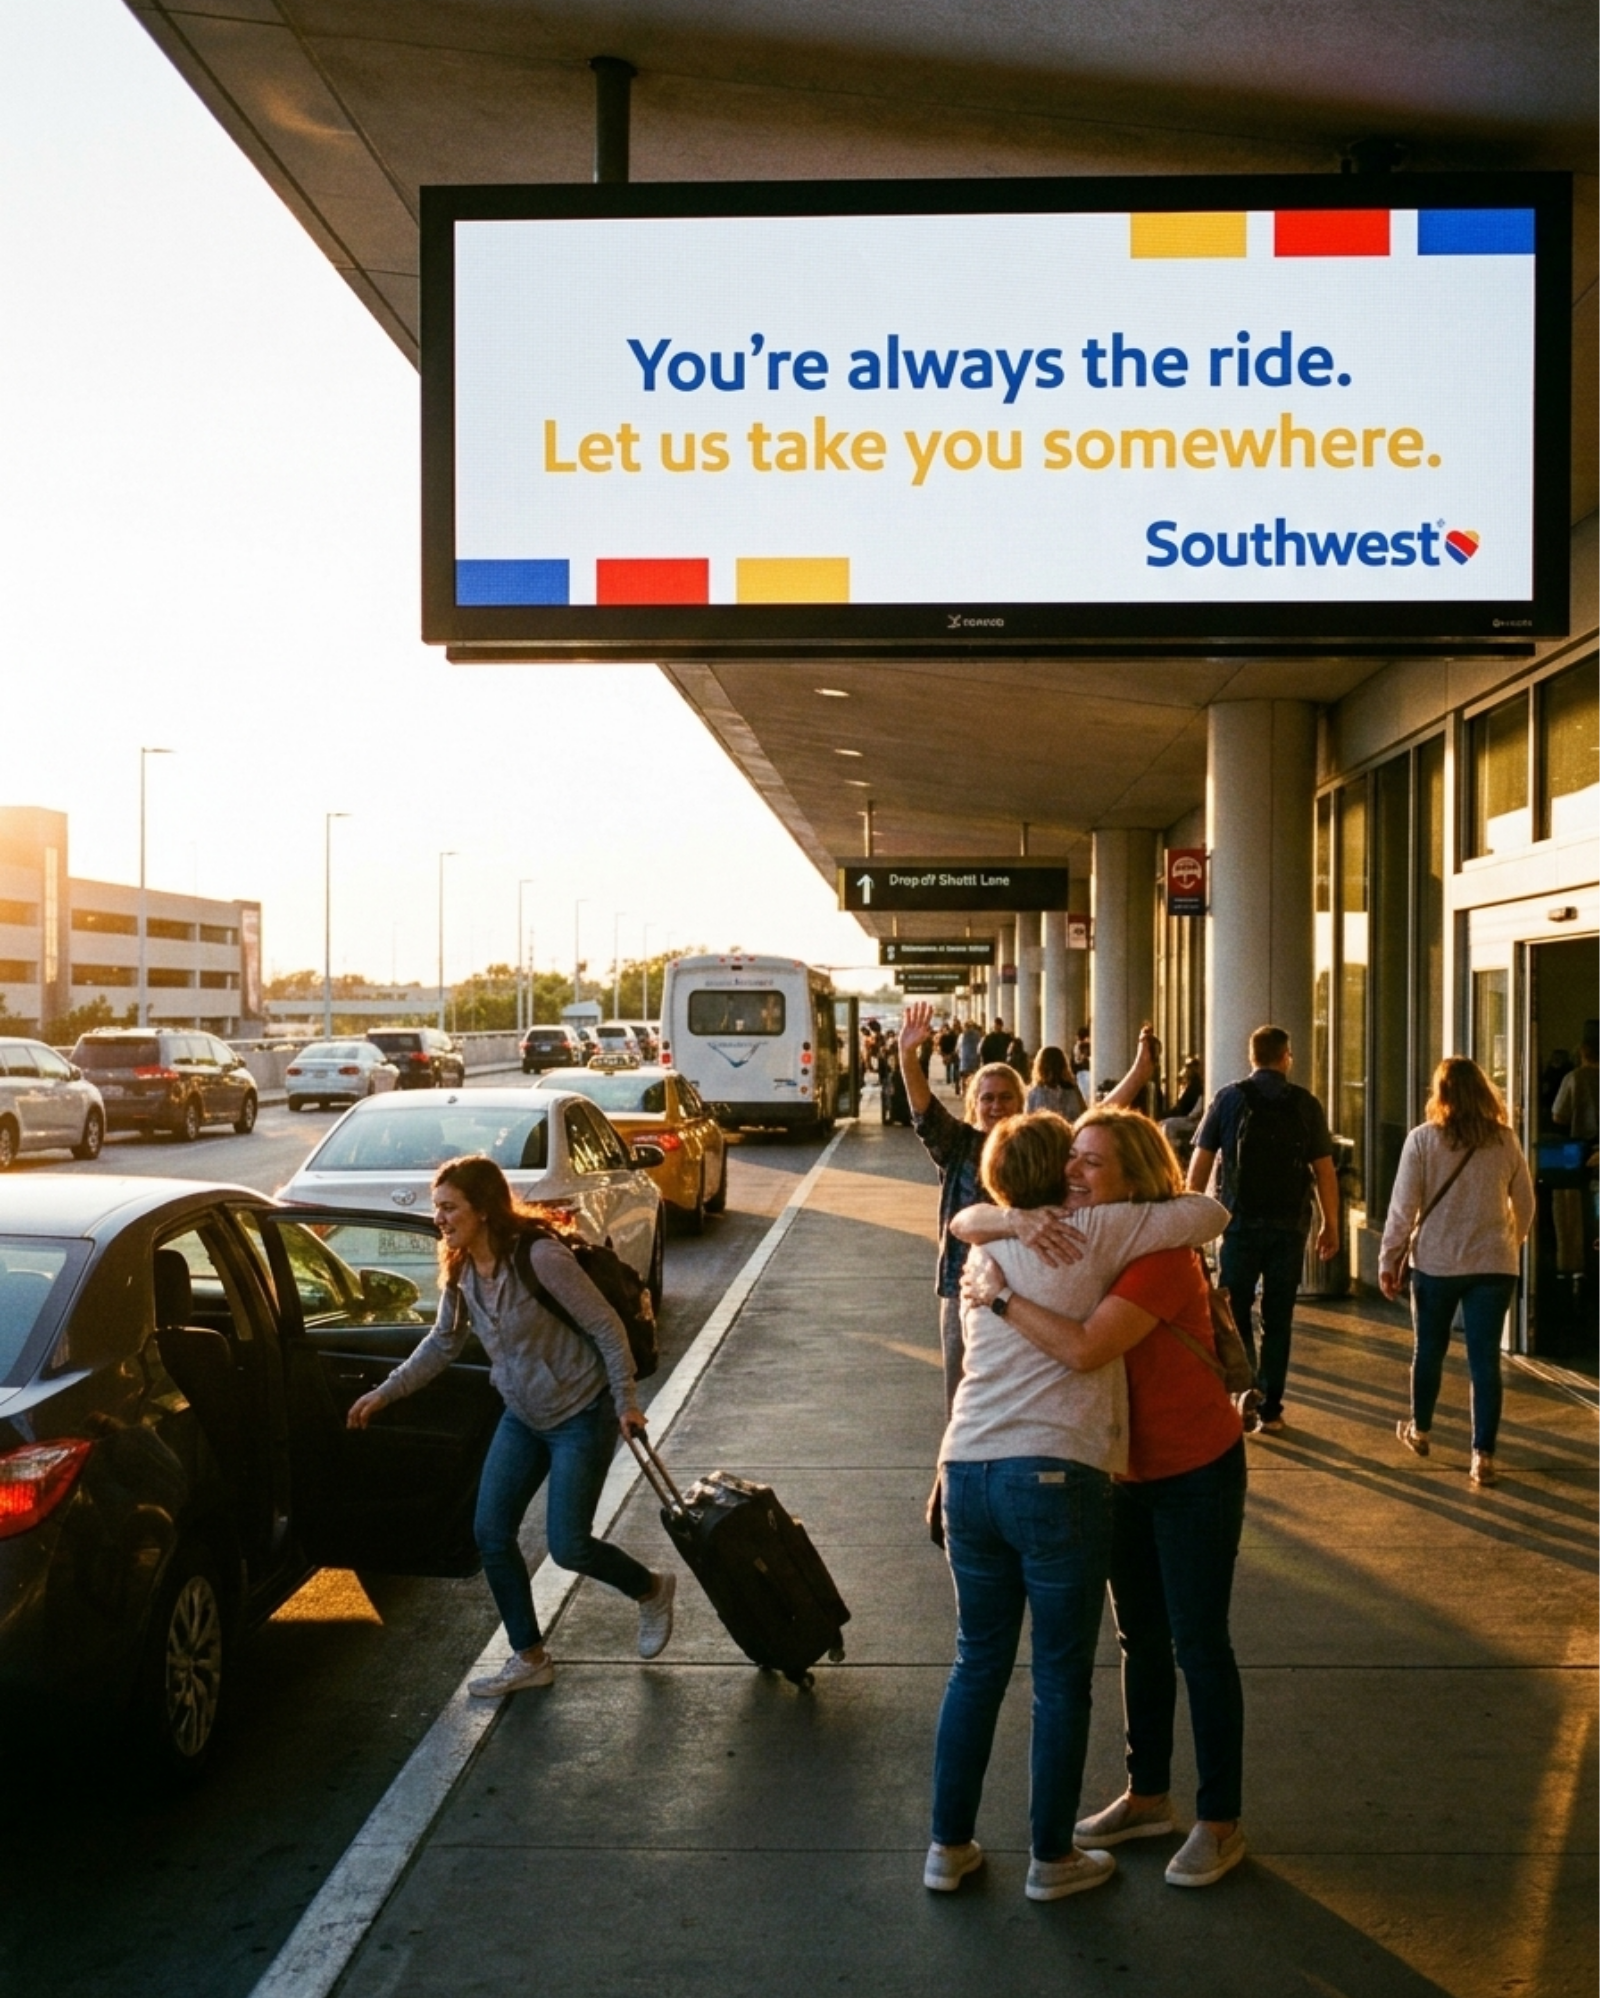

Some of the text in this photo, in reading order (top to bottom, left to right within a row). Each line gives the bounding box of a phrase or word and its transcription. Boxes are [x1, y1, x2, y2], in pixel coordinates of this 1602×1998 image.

[628, 330, 1352, 404] You’re always the ride.
[544, 412, 1441, 486] Let us take you somewhere.
[1146, 517, 1440, 568] Southwest
[889, 874, 920, 888] Drop
